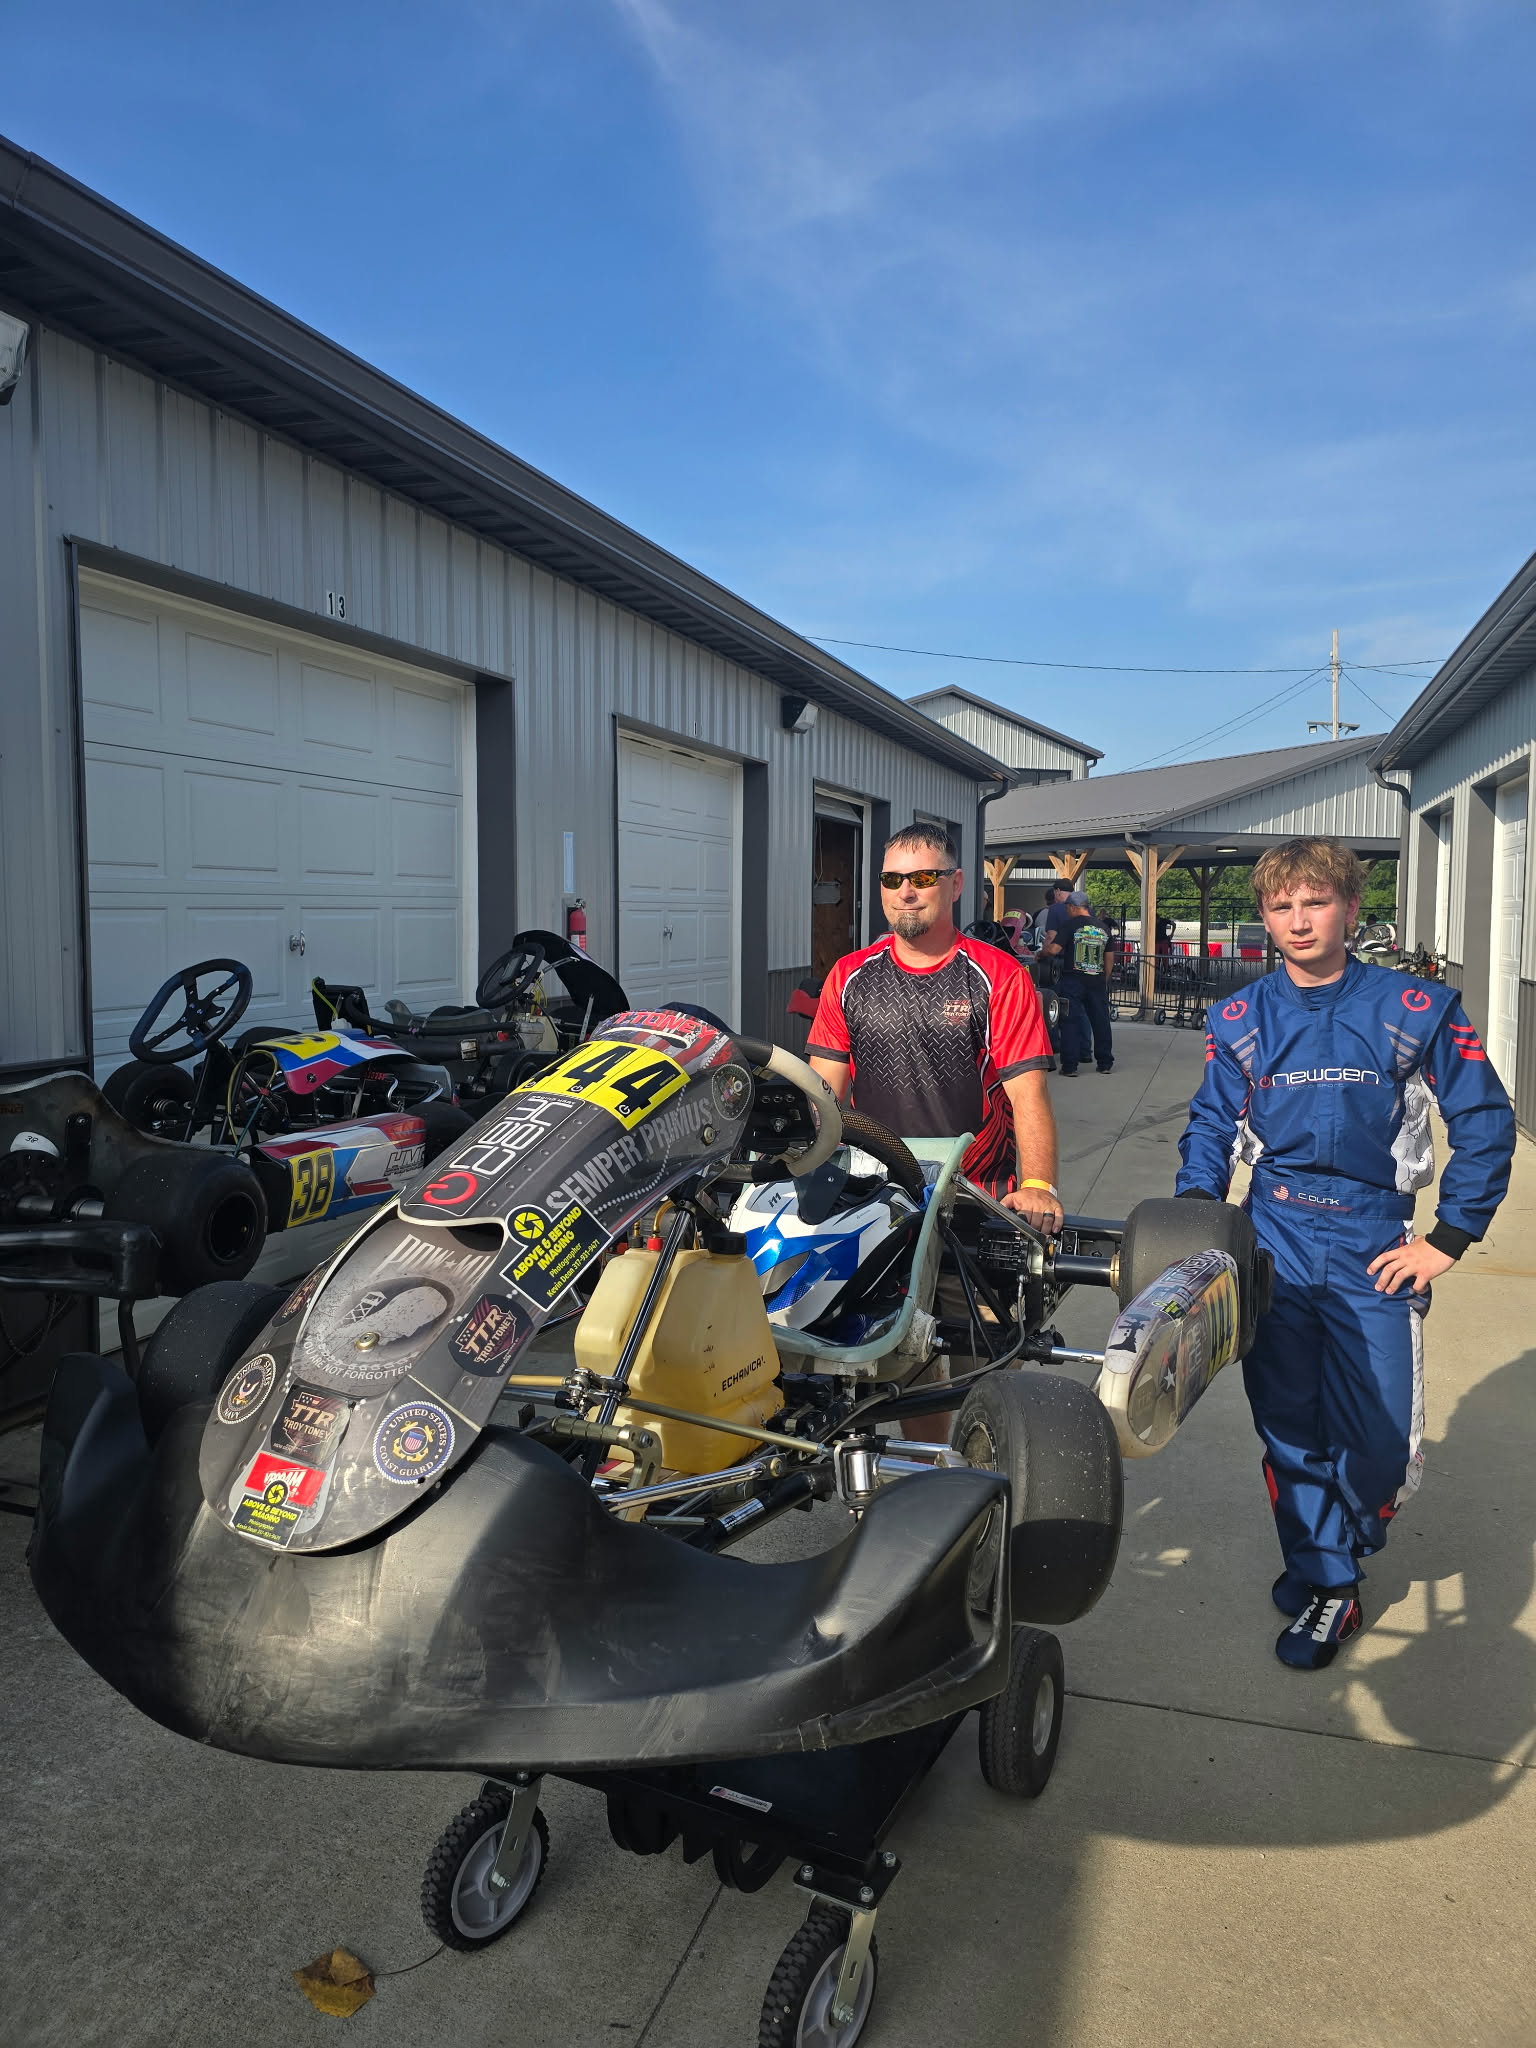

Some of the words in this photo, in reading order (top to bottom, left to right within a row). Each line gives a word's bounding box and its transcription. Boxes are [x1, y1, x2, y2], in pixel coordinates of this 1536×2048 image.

[329, 592, 345, 618] 13
[545, 1134, 644, 1208] SEMPER
[638, 1097, 713, 1155] PRIMUS
[289, 1152, 333, 1222] 38
[512, 1244, 546, 1281] ABOVE
[547, 1206, 582, 1241] BEYOND
[537, 1230, 575, 1270] IMAGING
[549, 1242, 582, 1278] Photographer
[546, 1279, 563, 1298] Kevin
[560, 1267, 575, 1282] Dean
[465, 1307, 503, 1354] TTR
[478, 1340, 497, 1362] TROY
[491, 1313, 514, 1341] TONEY
[303, 1335, 317, 1355] YOU
[236, 1358, 263, 1380] UNITED
[309, 1354, 324, 1368] ARE
[322, 1364, 343, 1376] NOT
[342, 1363, 412, 1380] FORGOTTEN
[223, 1407, 241, 1419] NAVY
[292, 1403, 336, 1427] TTR
[284, 1419, 305, 1431] TROY
[304, 1424, 332, 1440] TONEY
[389, 1408, 429, 1428] UNITED
[428, 1412, 448, 1446] STATES
[380, 1445, 399, 1472] COAST
[399, 1461, 434, 1476] GUARD
[242, 1498, 266, 1511] ABOVE
[270, 1507, 298, 1521] BEYOND
[251, 1509, 280, 1524] IMAGING
